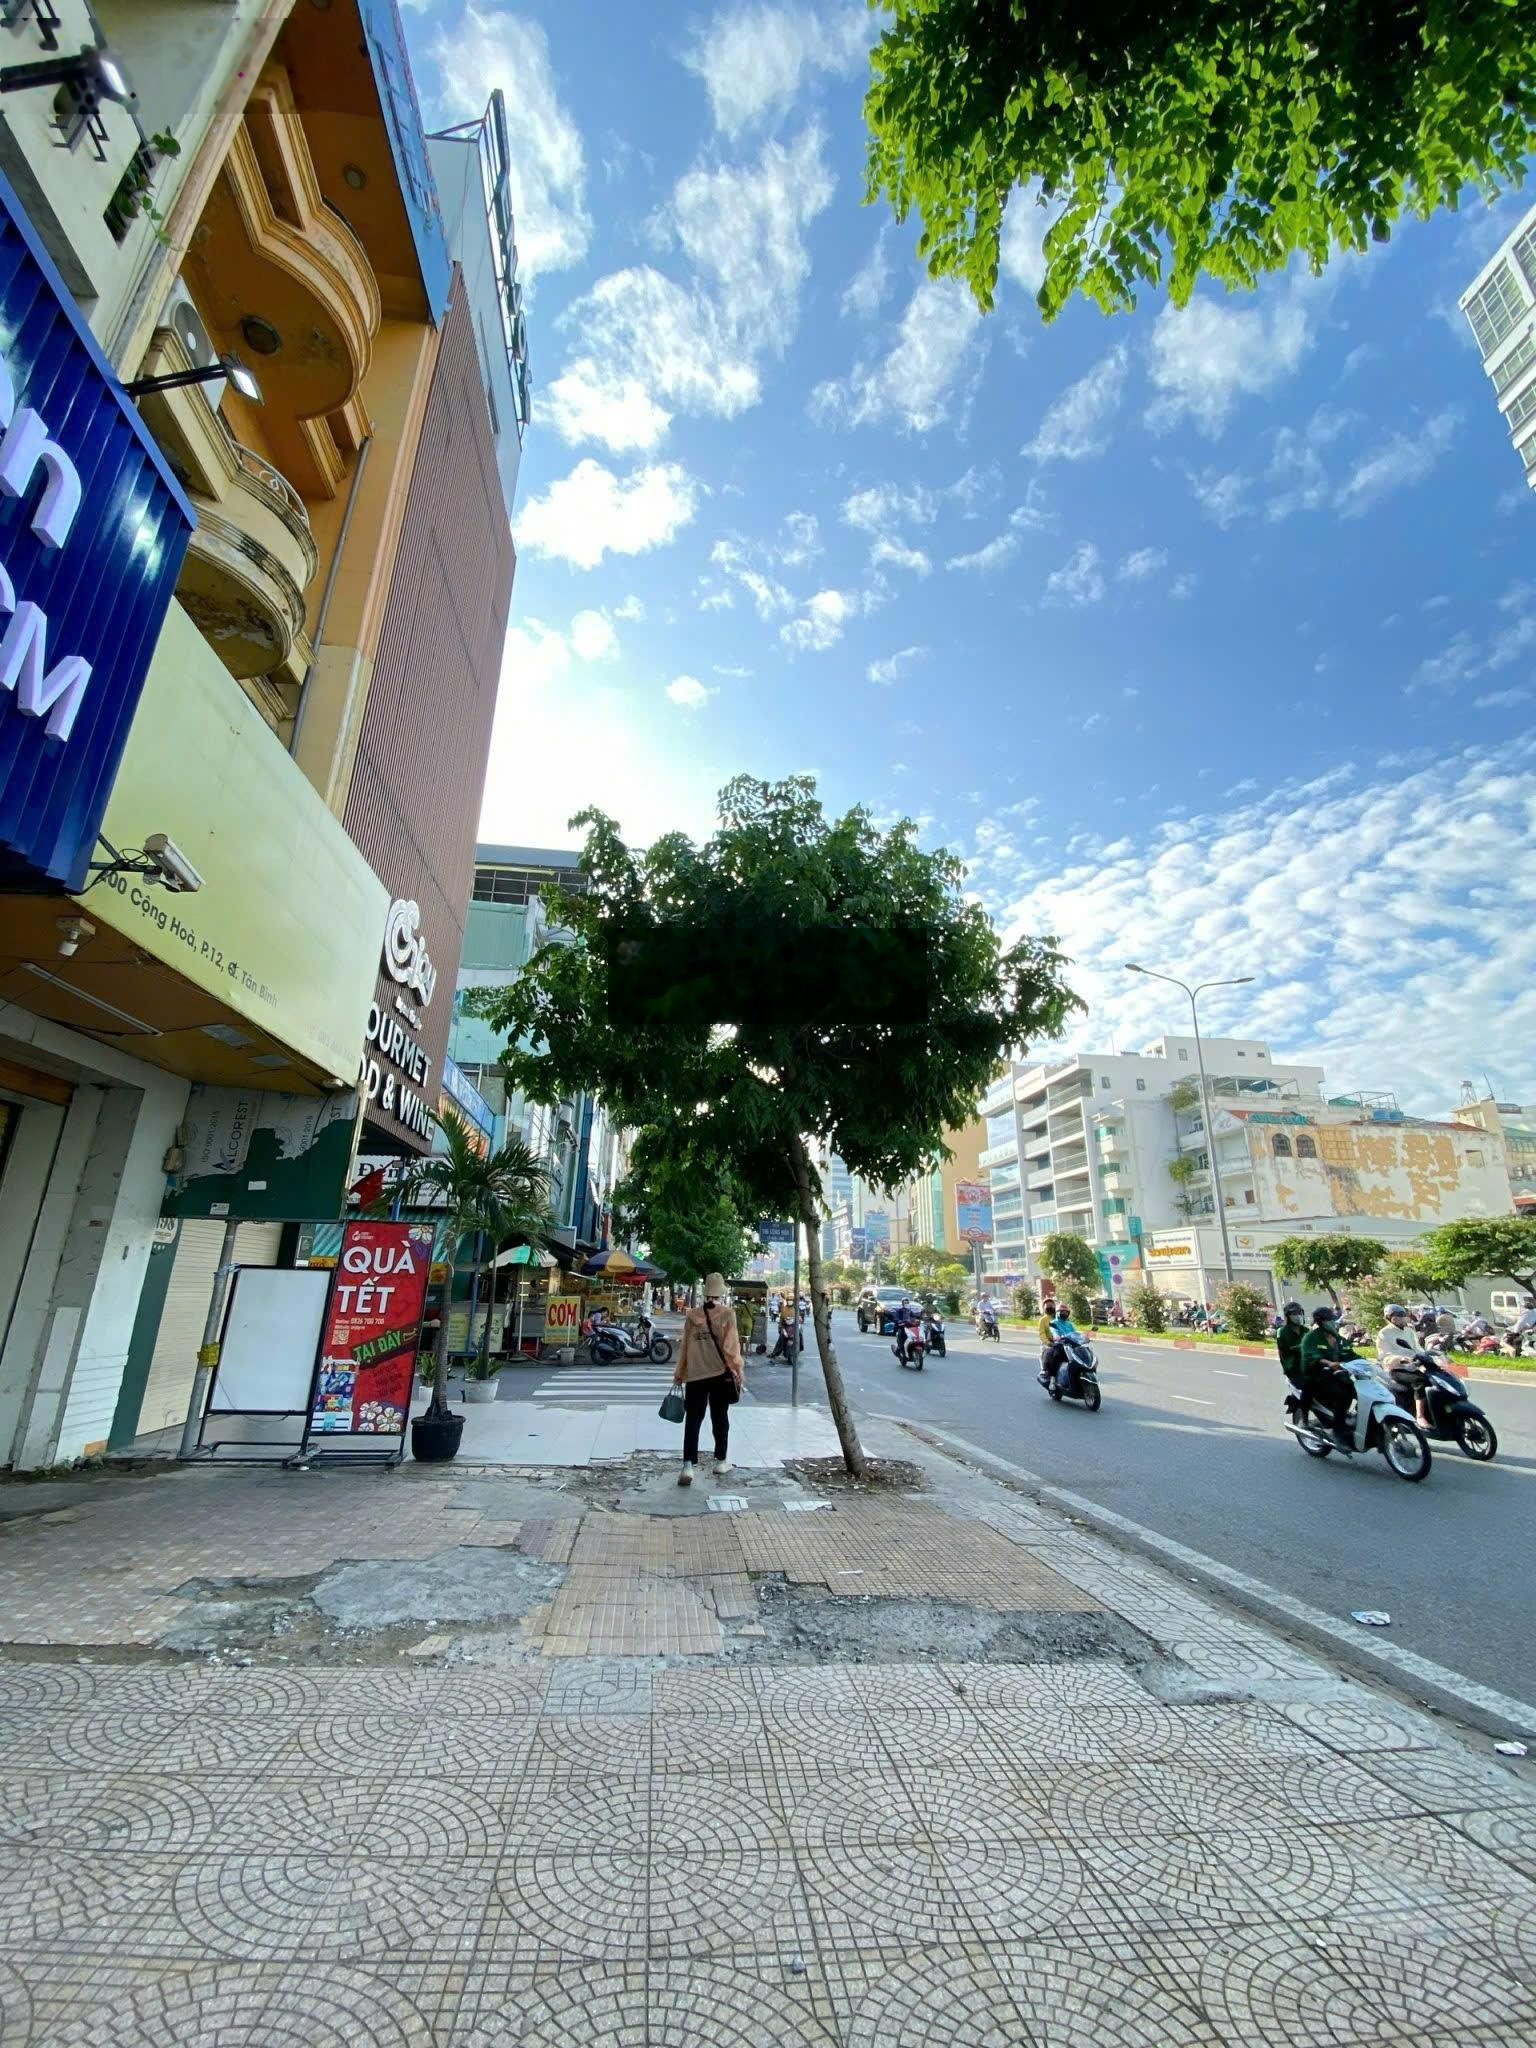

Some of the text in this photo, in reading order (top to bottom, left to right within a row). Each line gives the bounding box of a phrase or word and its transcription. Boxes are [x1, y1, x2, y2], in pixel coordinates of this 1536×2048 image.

[0, 562, 93, 742] M
[131, 888, 167, 930] Cộng
[201, 940, 224, 972] P.12,
[366, 1001, 431, 1088] OURMET
[383, 1073, 396, 1110] &
[400, 1084, 437, 1140] WINE
[343, 1240, 415, 1274] QUÀ
[337, 1276, 395, 1313] TẾT
[548, 1298, 578, 1327] CƠM
[353, 1330, 401, 1363] TẠI ĐÂY
